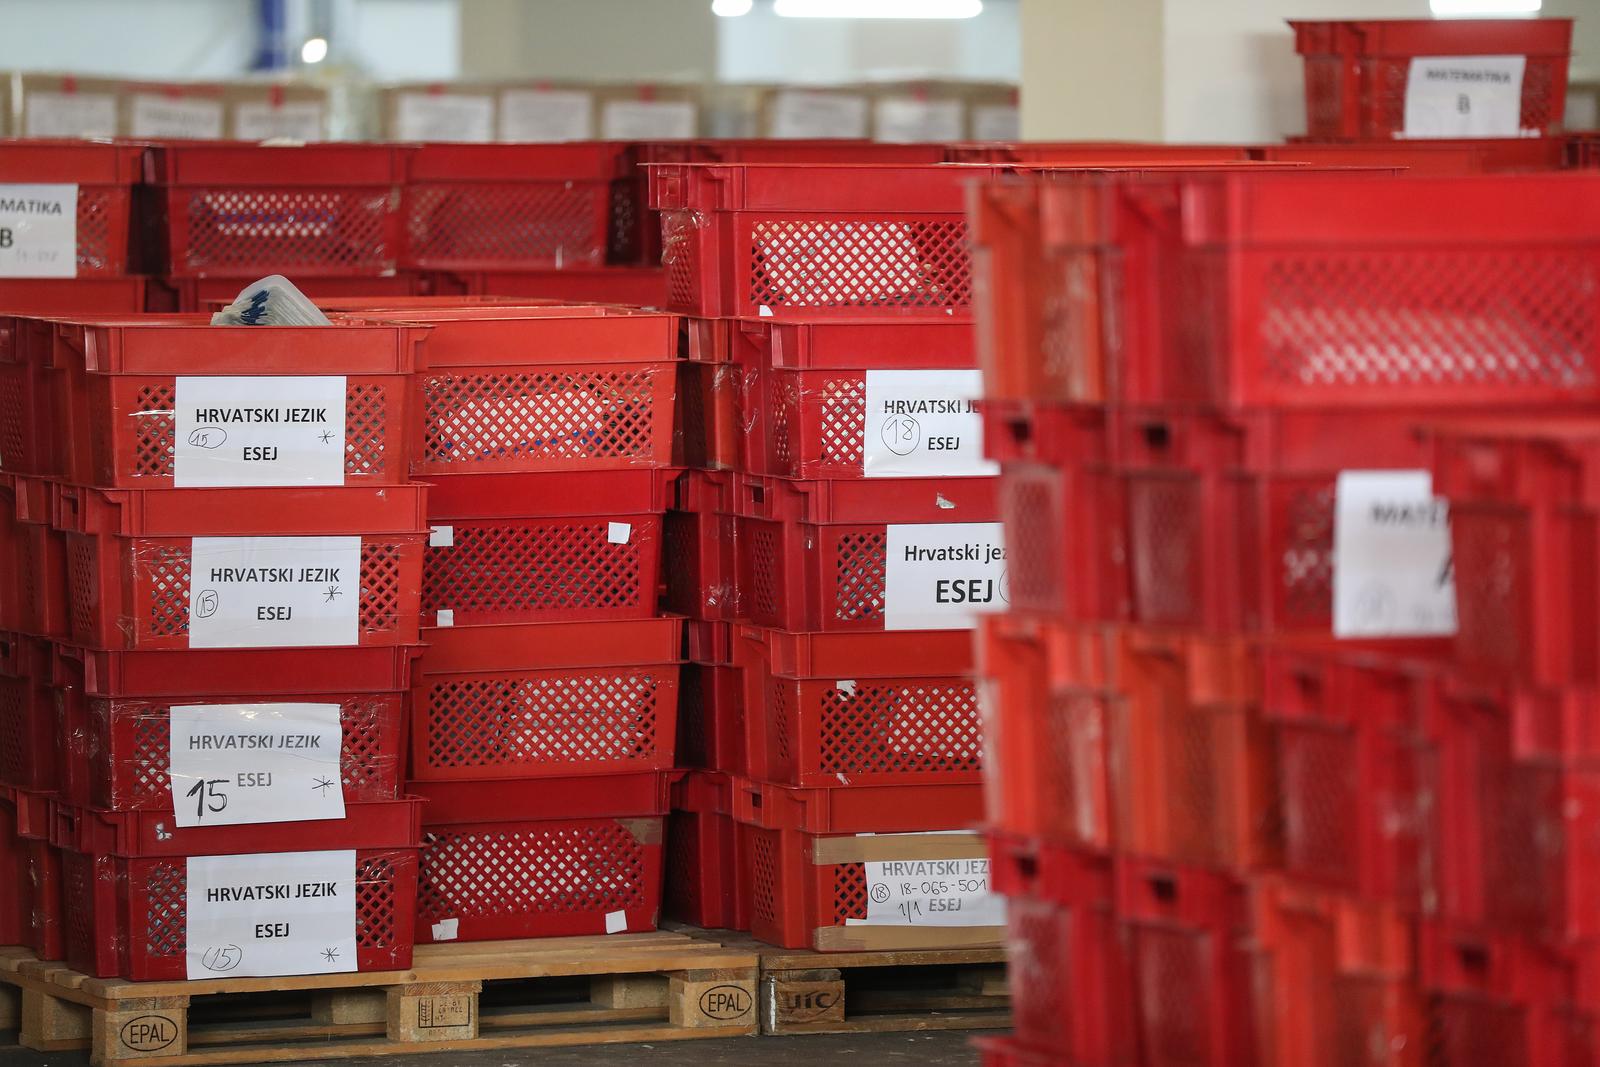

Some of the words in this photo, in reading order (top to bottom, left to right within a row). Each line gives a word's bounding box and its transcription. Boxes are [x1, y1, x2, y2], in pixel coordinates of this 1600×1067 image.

[0, 228, 13, 249] B
[884, 399, 961, 414] HRVATSKI
[196, 408, 279, 423] HRVATSKI
[284, 408, 327, 423] JEZIK
[927, 436, 960, 451] ESEJ
[243, 446, 278, 461] ESEJ
[904, 543, 980, 562] Hrvatski
[210, 567, 294, 583] HRVATSKI
[298, 567, 340, 583] JEZIK
[936, 579, 993, 604] ESEJ
[257, 606, 292, 621] ESEJ
[189, 734, 274, 750] HRVATSKI
[278, 734, 321, 749] JEZIK
[237, 772, 272, 788] ESEJ
[187, 779, 230, 824] 15
[882, 860, 961, 877] HRVATSKI
[207, 884, 290, 903] HRVATSKI
[294, 882, 337, 899] JEZIK
[928, 897, 962, 912] ESEJ
[255, 923, 290, 939] ESEJ
[209, 948, 237, 970] 15
[708, 992, 745, 1013] EPAL
[130, 1022, 170, 1045] EPAL
